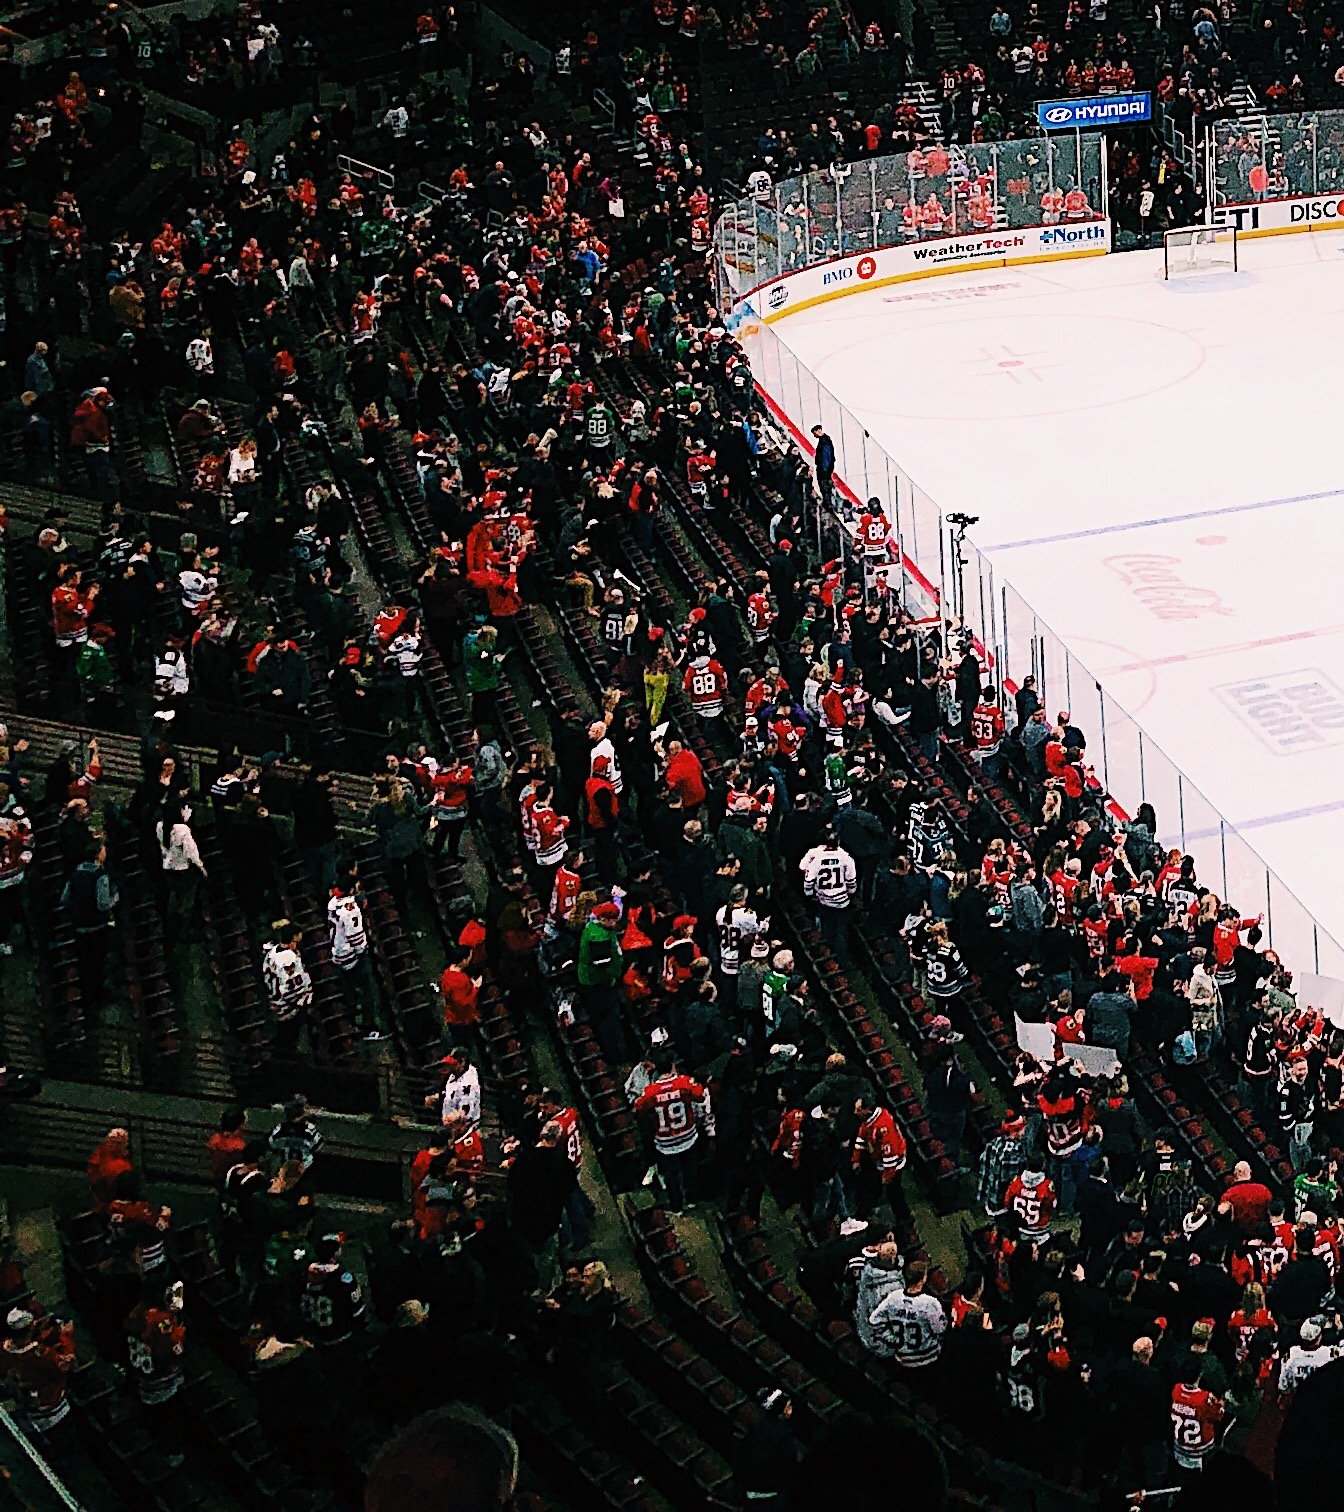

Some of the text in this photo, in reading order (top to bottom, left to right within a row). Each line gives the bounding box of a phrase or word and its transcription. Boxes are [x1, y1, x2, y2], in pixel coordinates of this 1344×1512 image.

[944, 77, 954, 88] 10
[1076, 102, 1145, 119] HYUNDAI
[1053, 225, 1105, 244] North
[914, 236, 1024, 260] WeatherTech
[823, 268, 852, 285] BMO
[588, 416, 608, 435] 88
[692, 674, 716, 696] 88
[1225, 682, 1327, 748] LIGHT
[973, 722, 993, 741] 33
[818, 868, 843, 891] 21
[654, 1099, 686, 1132] 19
